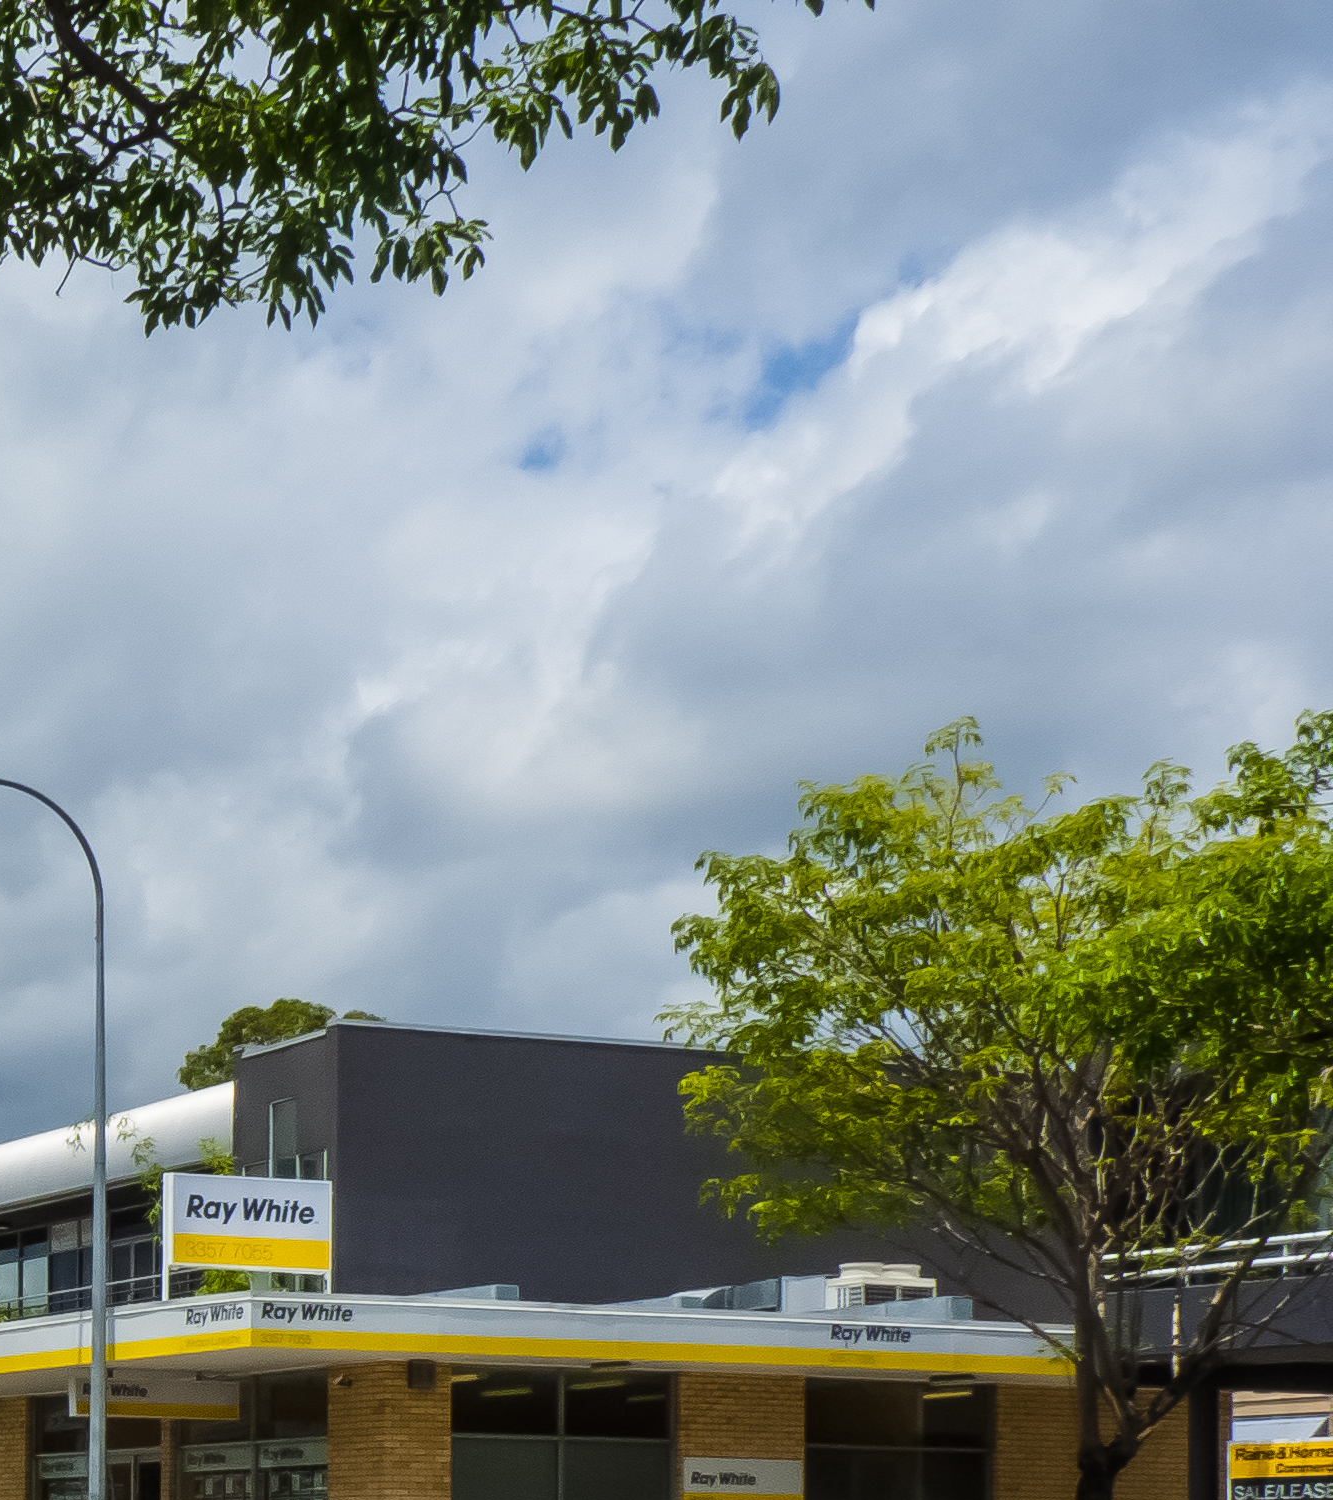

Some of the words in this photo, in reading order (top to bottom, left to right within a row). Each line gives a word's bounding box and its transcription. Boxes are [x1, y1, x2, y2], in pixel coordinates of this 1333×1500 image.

[185, 1193, 238, 1225] Ray
[242, 1196, 315, 1225] White
[184, 1240, 227, 1258] 3357
[185, 1308, 208, 1327] Ray
[210, 1304, 244, 1322] White
[261, 1302, 298, 1323] Ray
[301, 1303, 353, 1323] White
[830, 1324, 863, 1344] Ray
[864, 1325, 911, 1343] White
[691, 1471, 717, 1488] Ray
[719, 1471, 756, 1486] White
